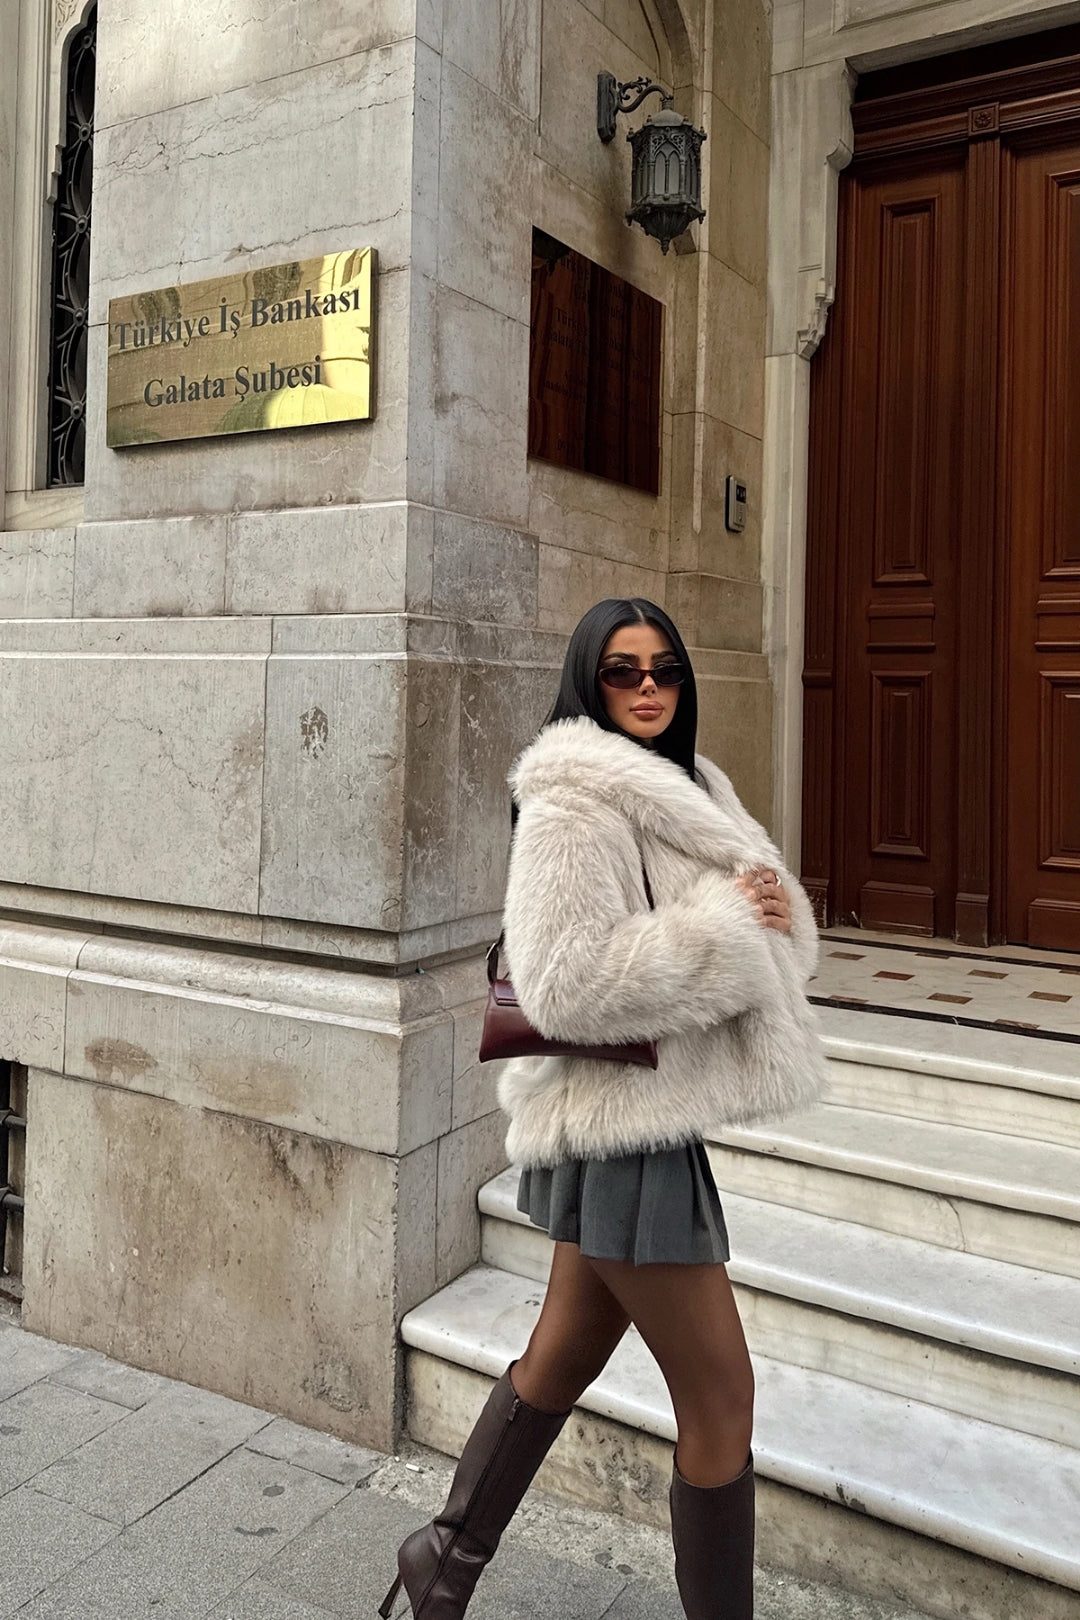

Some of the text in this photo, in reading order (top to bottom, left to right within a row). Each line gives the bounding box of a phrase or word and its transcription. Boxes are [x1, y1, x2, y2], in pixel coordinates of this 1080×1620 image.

[114, 288, 360, 350] Türkiye İş Bankası
[143, 355, 322, 408] Galata Şubesi
